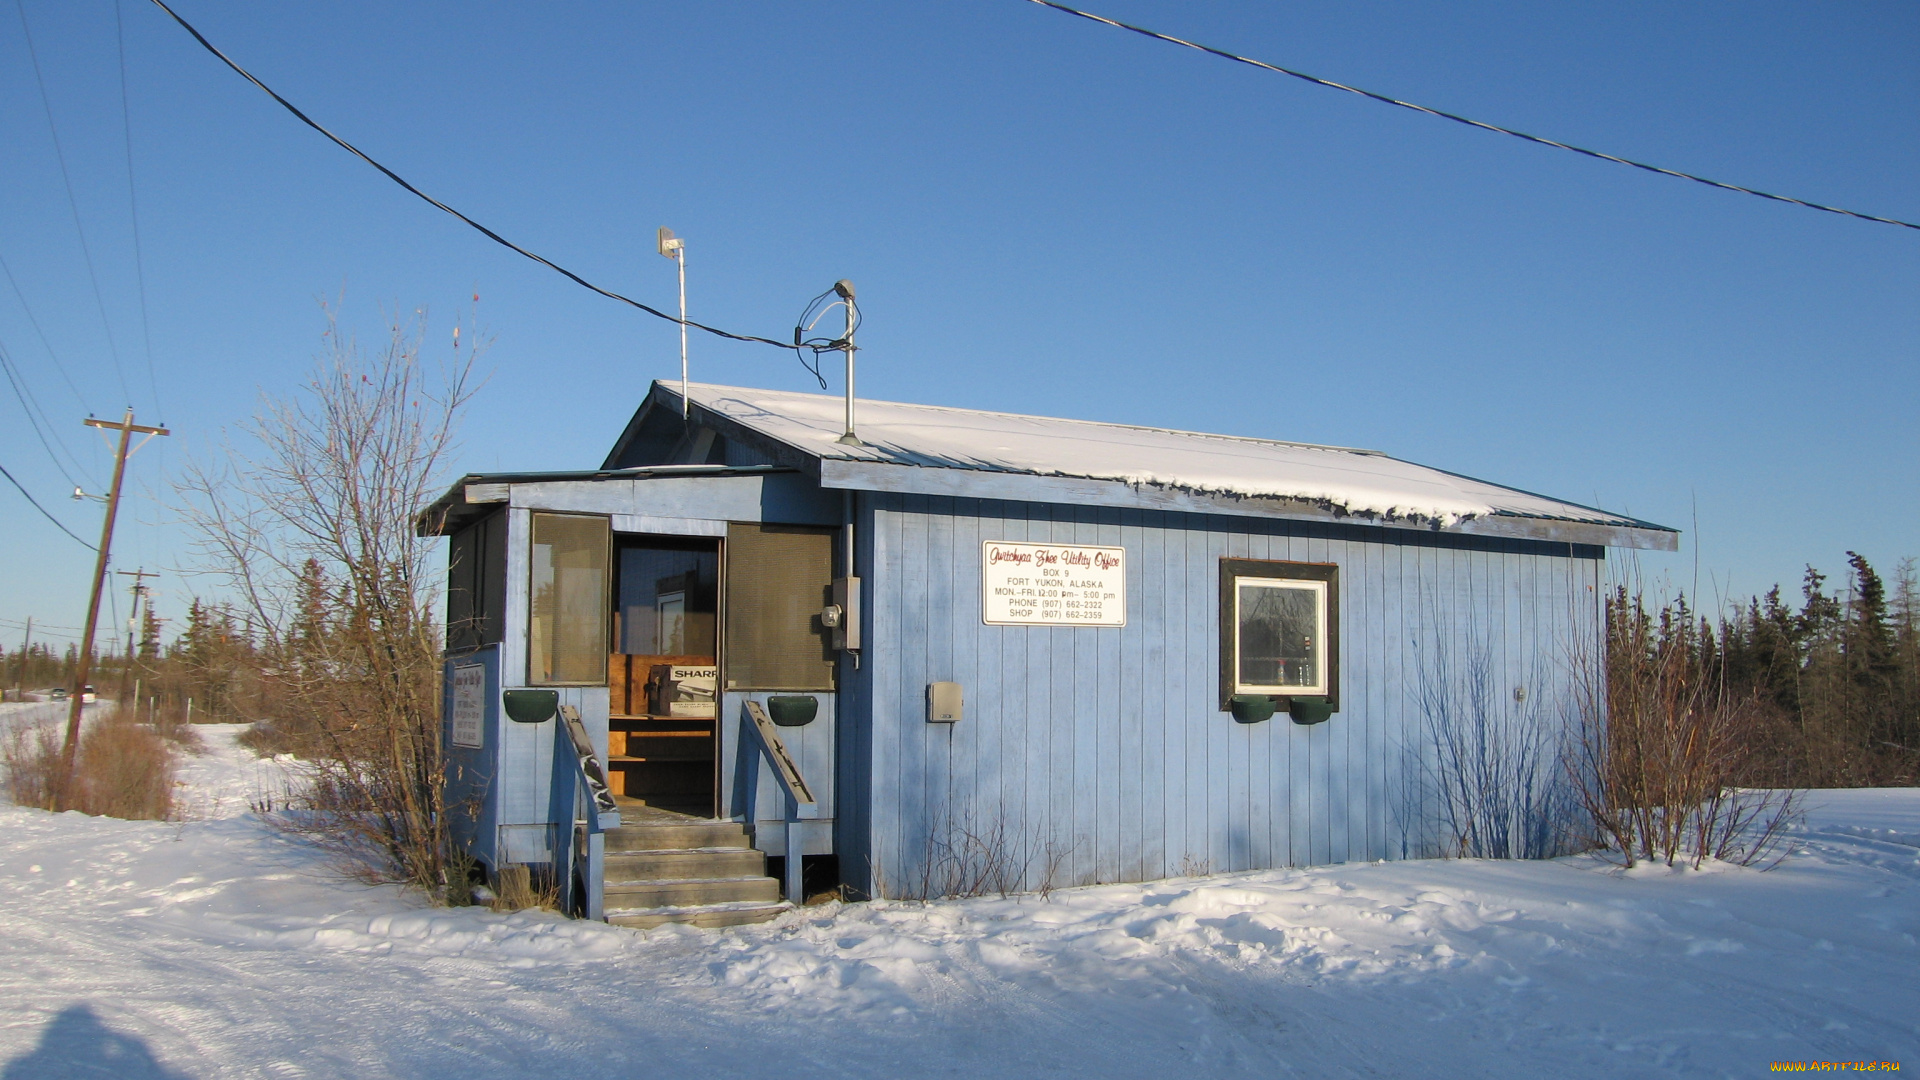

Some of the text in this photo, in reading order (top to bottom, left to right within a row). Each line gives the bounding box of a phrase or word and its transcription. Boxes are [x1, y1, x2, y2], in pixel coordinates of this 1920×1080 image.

[1061, 550, 1092, 569] Utility
[1095, 551, 1120, 570] Office
[1043, 568, 1060, 577] BOX
[1007, 577, 1104, 589] FORT YUKON, ALASKA
[1083, 591, 1100, 599] 5:00
[1103, 592, 1116, 601] pm
[1009, 598, 1103, 609] PHONE (907) 662-2322
[1009, 608, 1102, 620] SHOP (907) 662-2359
